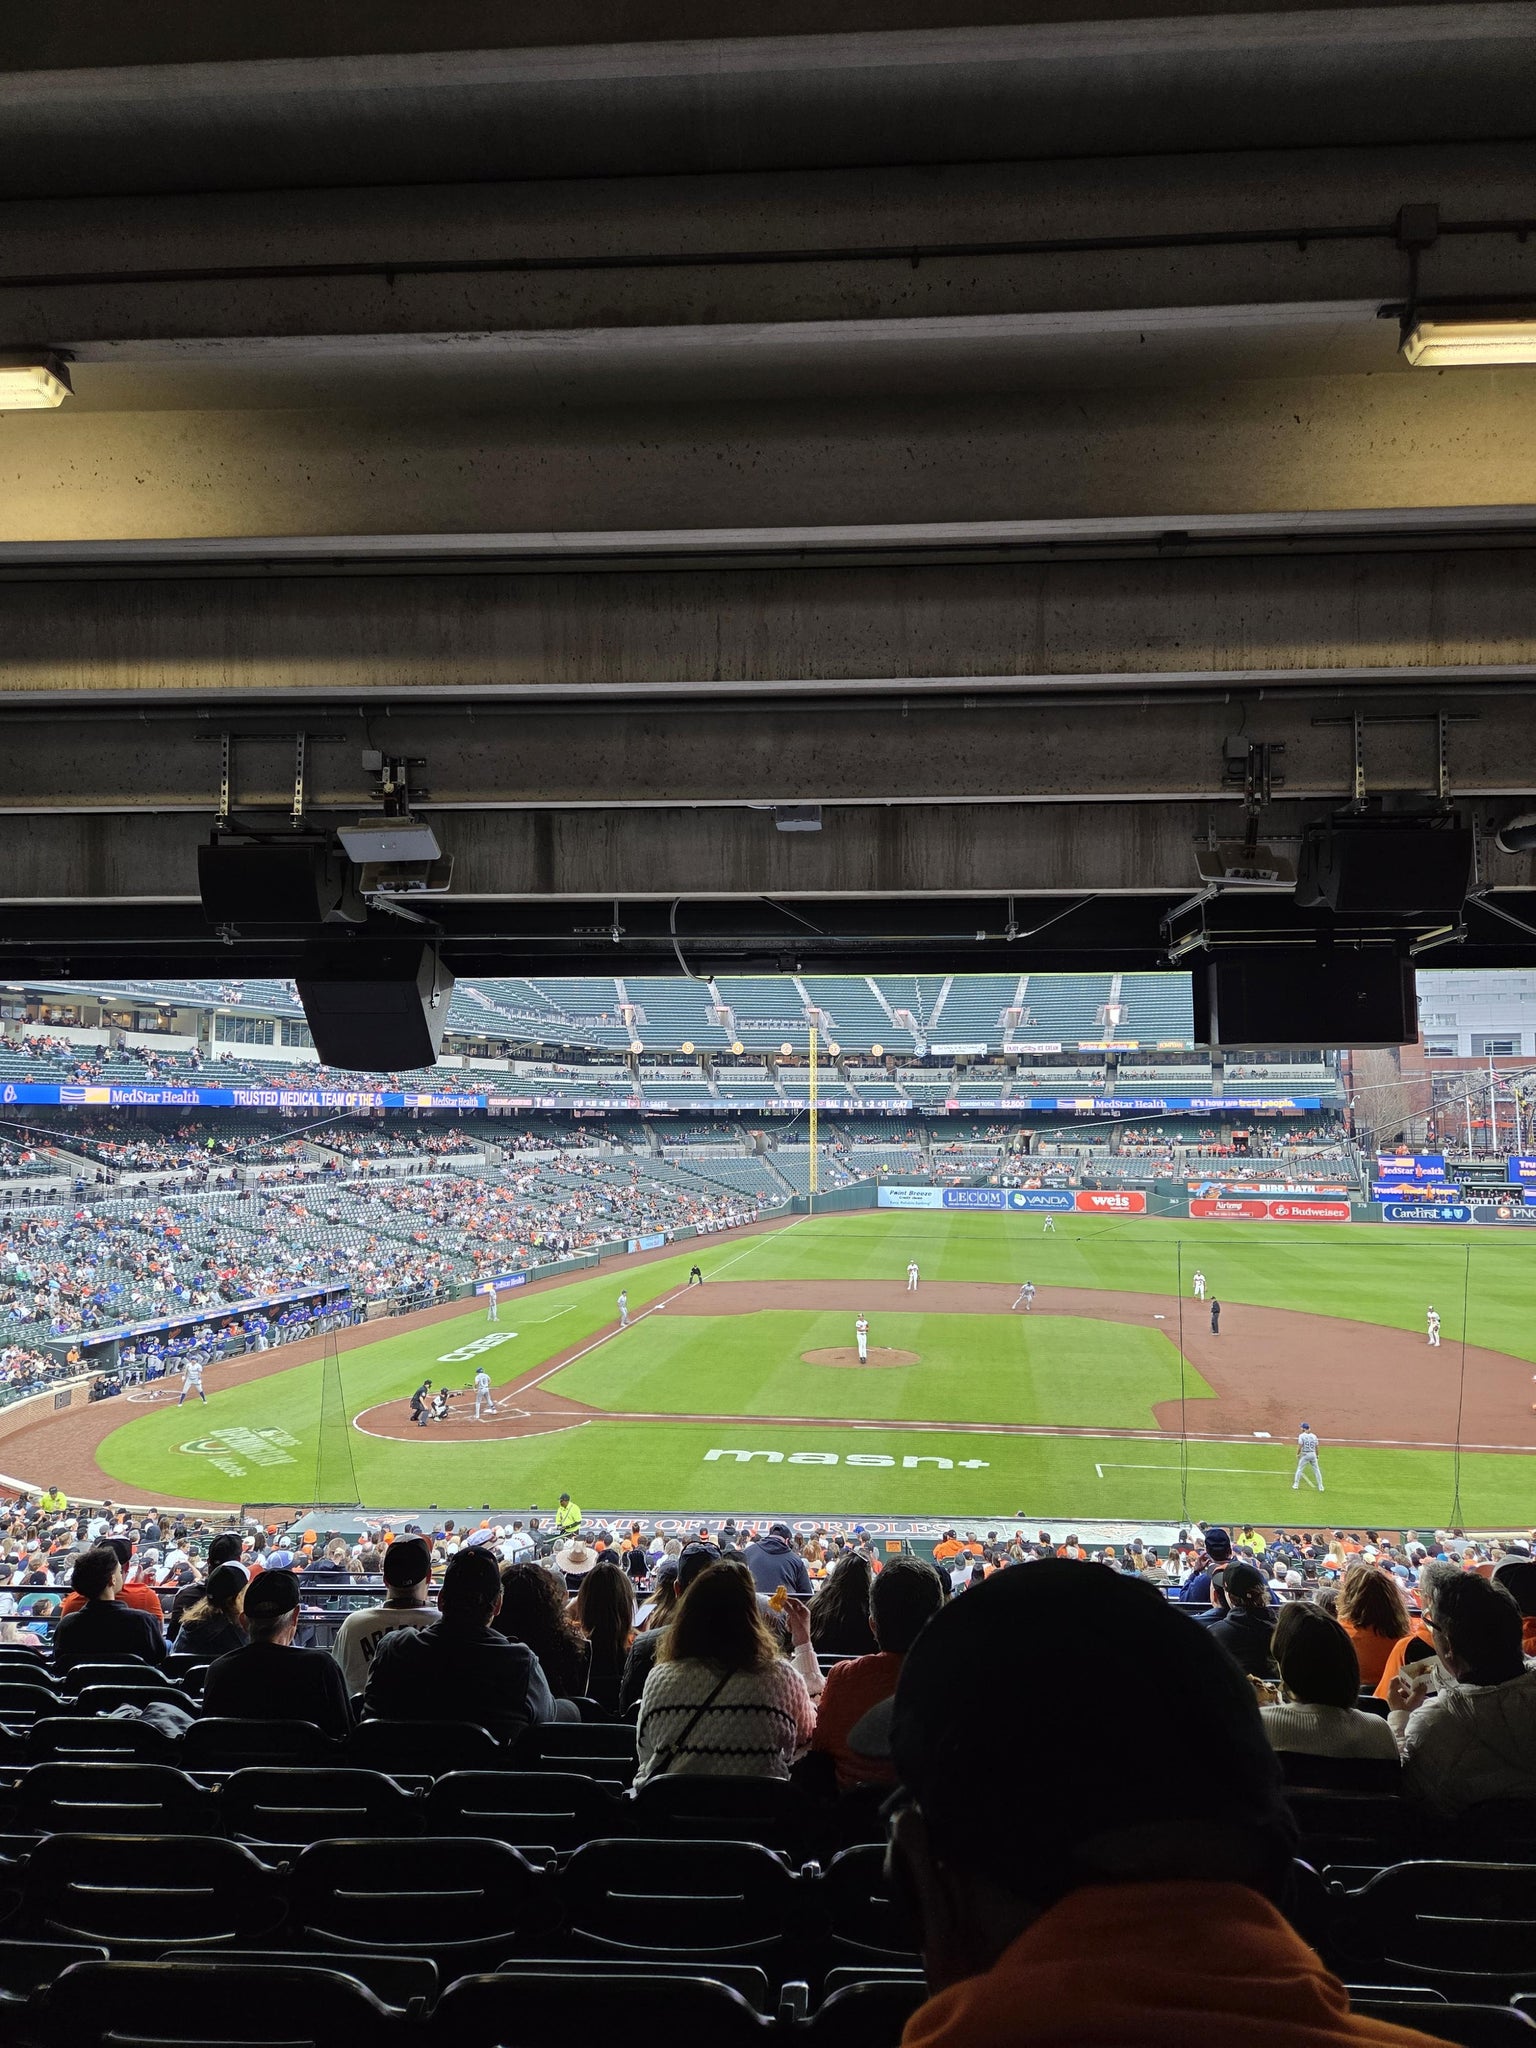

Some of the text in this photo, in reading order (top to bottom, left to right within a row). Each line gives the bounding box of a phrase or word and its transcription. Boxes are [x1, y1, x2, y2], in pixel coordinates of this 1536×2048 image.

[112, 1090, 200, 1104] MedStar Health
[233, 1091, 375, 1106] TRUSTED MEDICAL TEAM OF THE
[432, 1096, 457, 1106] MedStar
[458, 1096, 478, 1107] Health
[1095, 1099, 1167, 1109] MedStar Health
[1190, 1099, 1203, 1107] It's
[1204, 1099, 1223, 1107] how
[1258, 1185, 1280, 1193] BIRD
[1289, 1185, 1315, 1193] BATH
[948, 1192, 1001, 1203] LECOM
[1026, 1195, 1069, 1205] VANDA
[1091, 1194, 1130, 1207] weis
[1291, 1207, 1344, 1217] Budweiser
[1392, 1207, 1440, 1218] CareFirst
[703, 1449, 990, 1469] masn+
[654, 1519, 702, 1531] OF
[793, 1521, 951, 1533] ORIOLES
